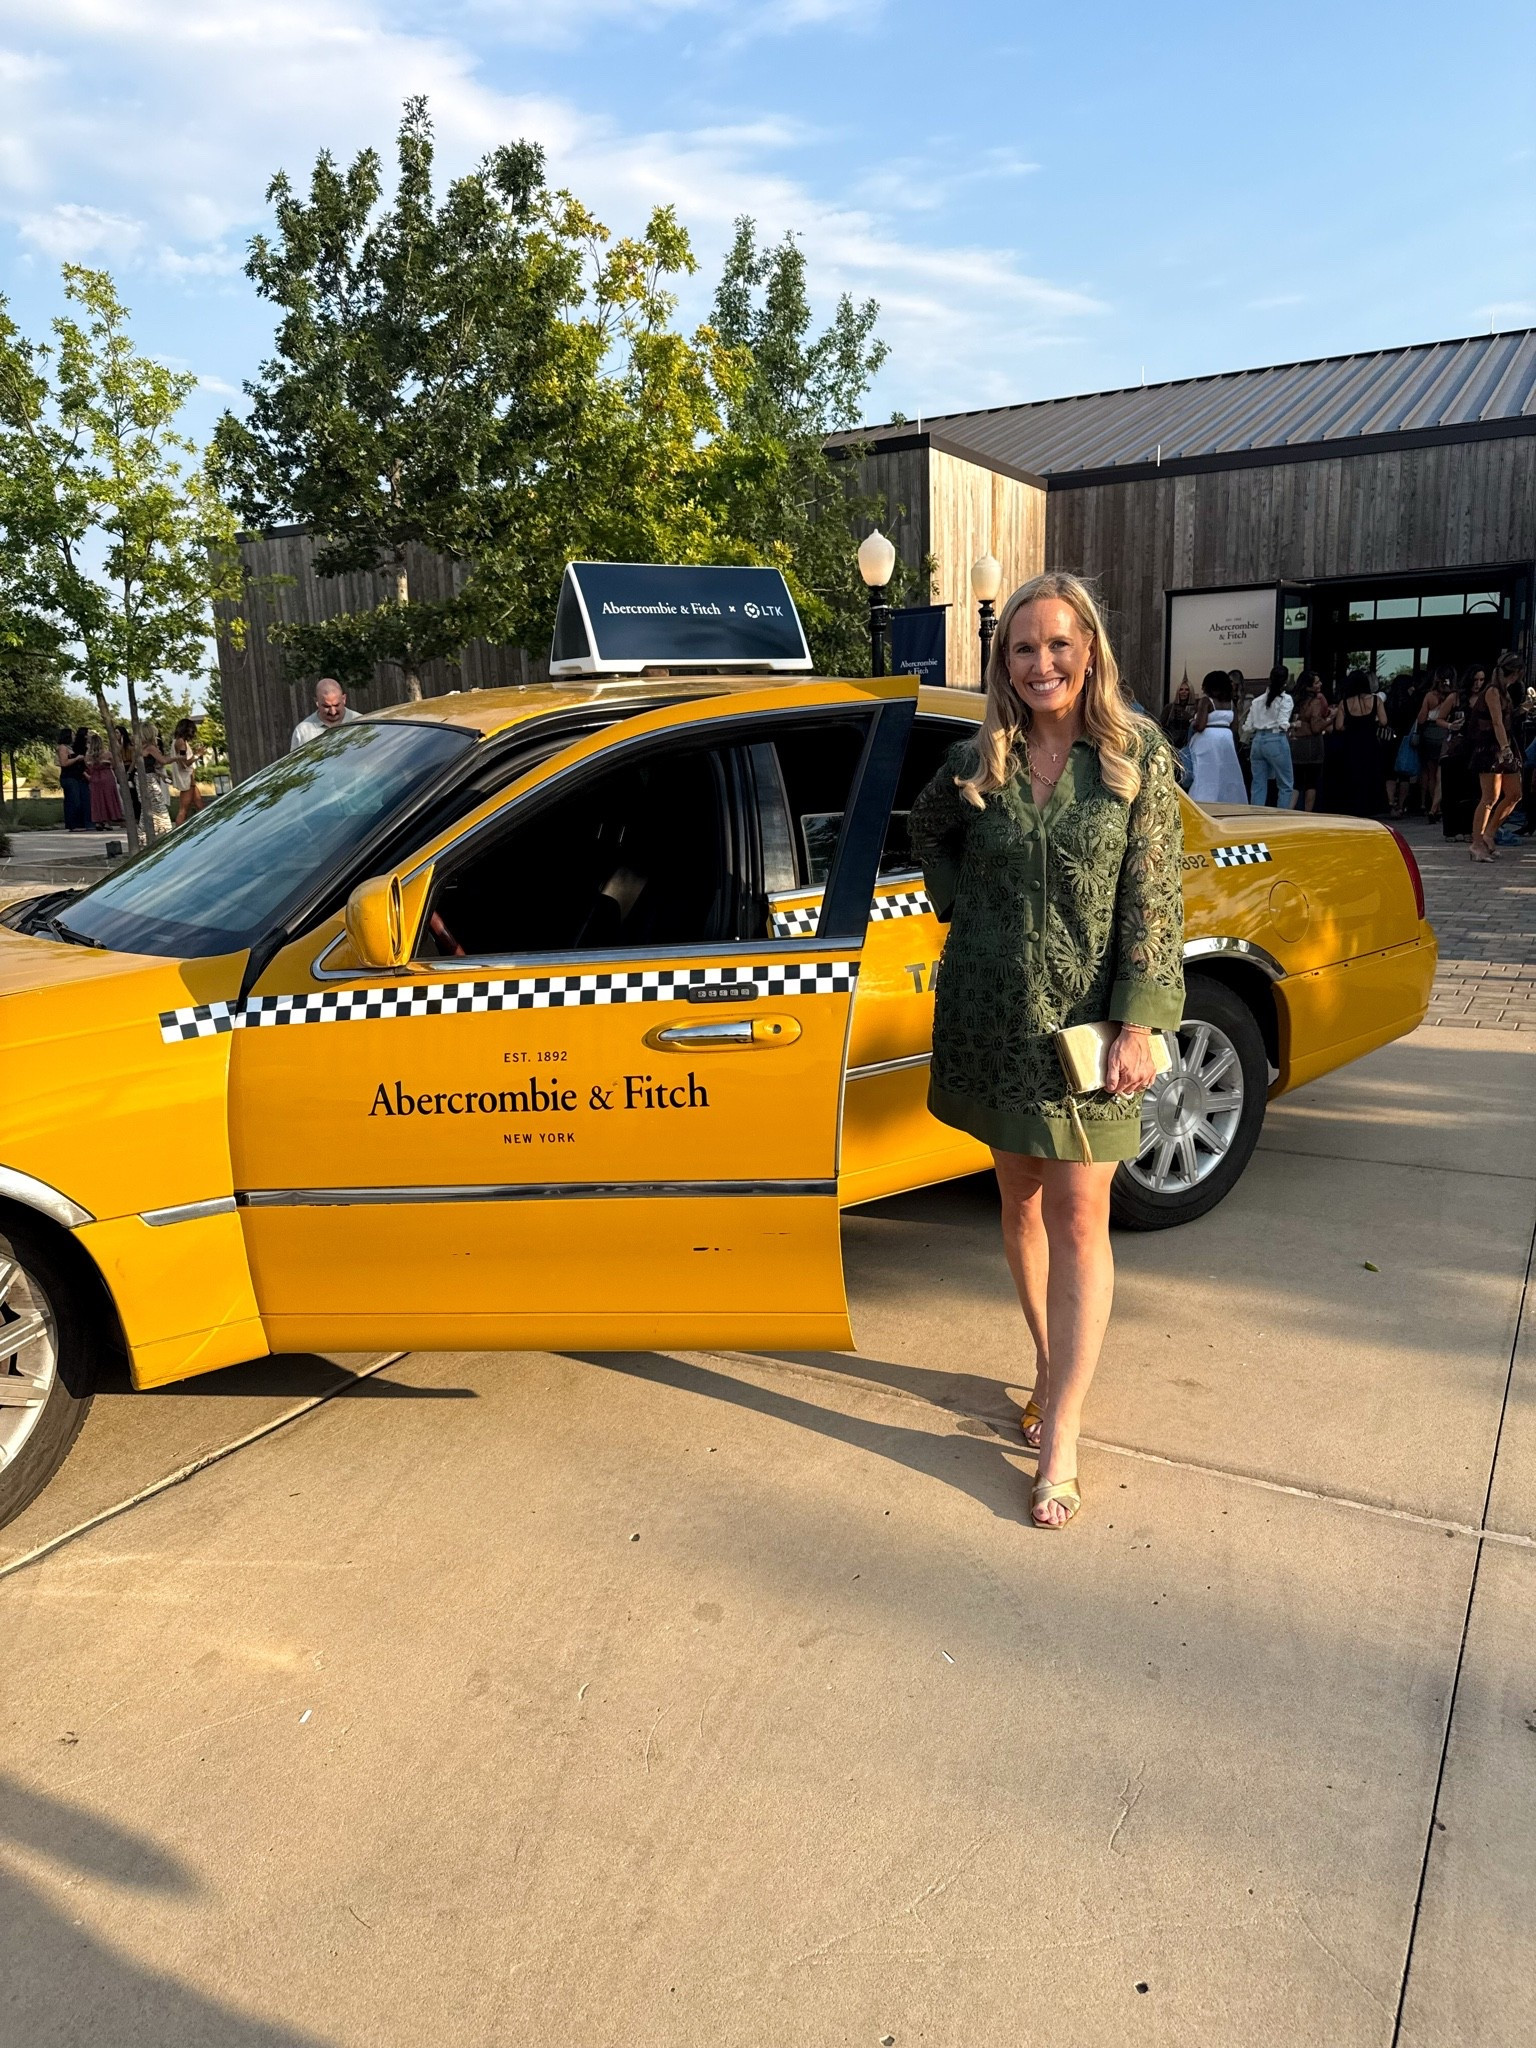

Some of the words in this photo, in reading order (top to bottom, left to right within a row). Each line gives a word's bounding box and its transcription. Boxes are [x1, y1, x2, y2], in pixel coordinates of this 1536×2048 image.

[602, 602, 677, 615] Abercrombie
[680, 604, 690, 615] &
[691, 602, 722, 616] Fitch
[761, 606, 784, 617] LTK
[1209, 621, 1259, 632] Abercrombie
[1227, 631, 1247, 640] Fitch
[900, 658, 938, 669] Abercrombie
[914, 667, 929, 675] Fitch
[504, 1053, 531, 1063] EST.
[537, 1051, 568, 1062] 1892
[368, 1077, 578, 1117] Abercrombie
[588, 1085, 615, 1111] &
[622, 1071, 711, 1110] Fitch
[503, 1134, 533, 1144] NEW
[539, 1132, 576, 1144] YORK
